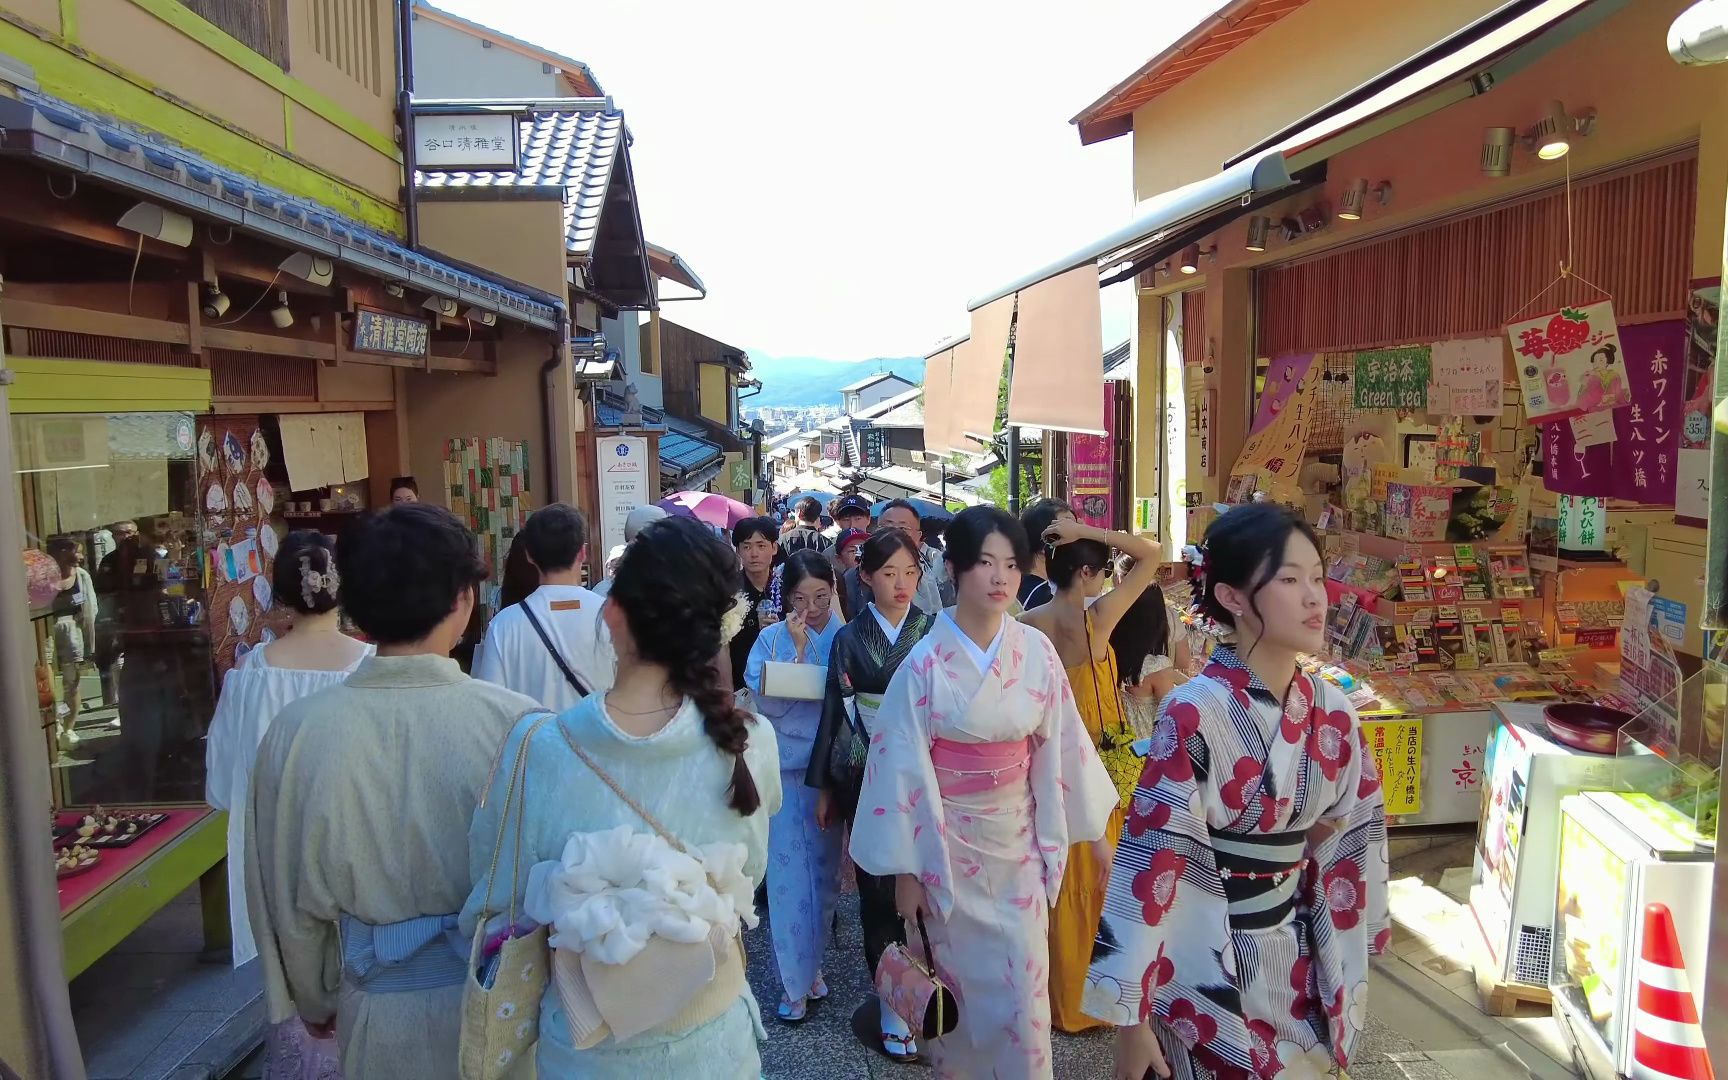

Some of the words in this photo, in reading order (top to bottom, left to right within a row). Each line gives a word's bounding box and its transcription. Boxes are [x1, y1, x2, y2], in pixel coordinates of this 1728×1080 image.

[424, 136, 506, 151] 谷口清雅堂
[369, 314, 428, 355] 清雅堂陶苑
[1367, 357, 1414, 382] 宇治茶
[1360, 388, 1393, 407] Green
[1400, 389, 1421, 407] tea
[1650, 350, 1670, 444] 赤ワイン
[1264, 403, 1304, 474] 生八ツ橋
[1629, 403, 1647, 488] 生八ツ橋
[733, 465, 749, 486] 茶
[1658, 453, 1667, 483] 餡入り
[1578, 495, 1597, 546] わらび餅
[1405, 726, 1417, 805] 当店の生八ツ橋は
